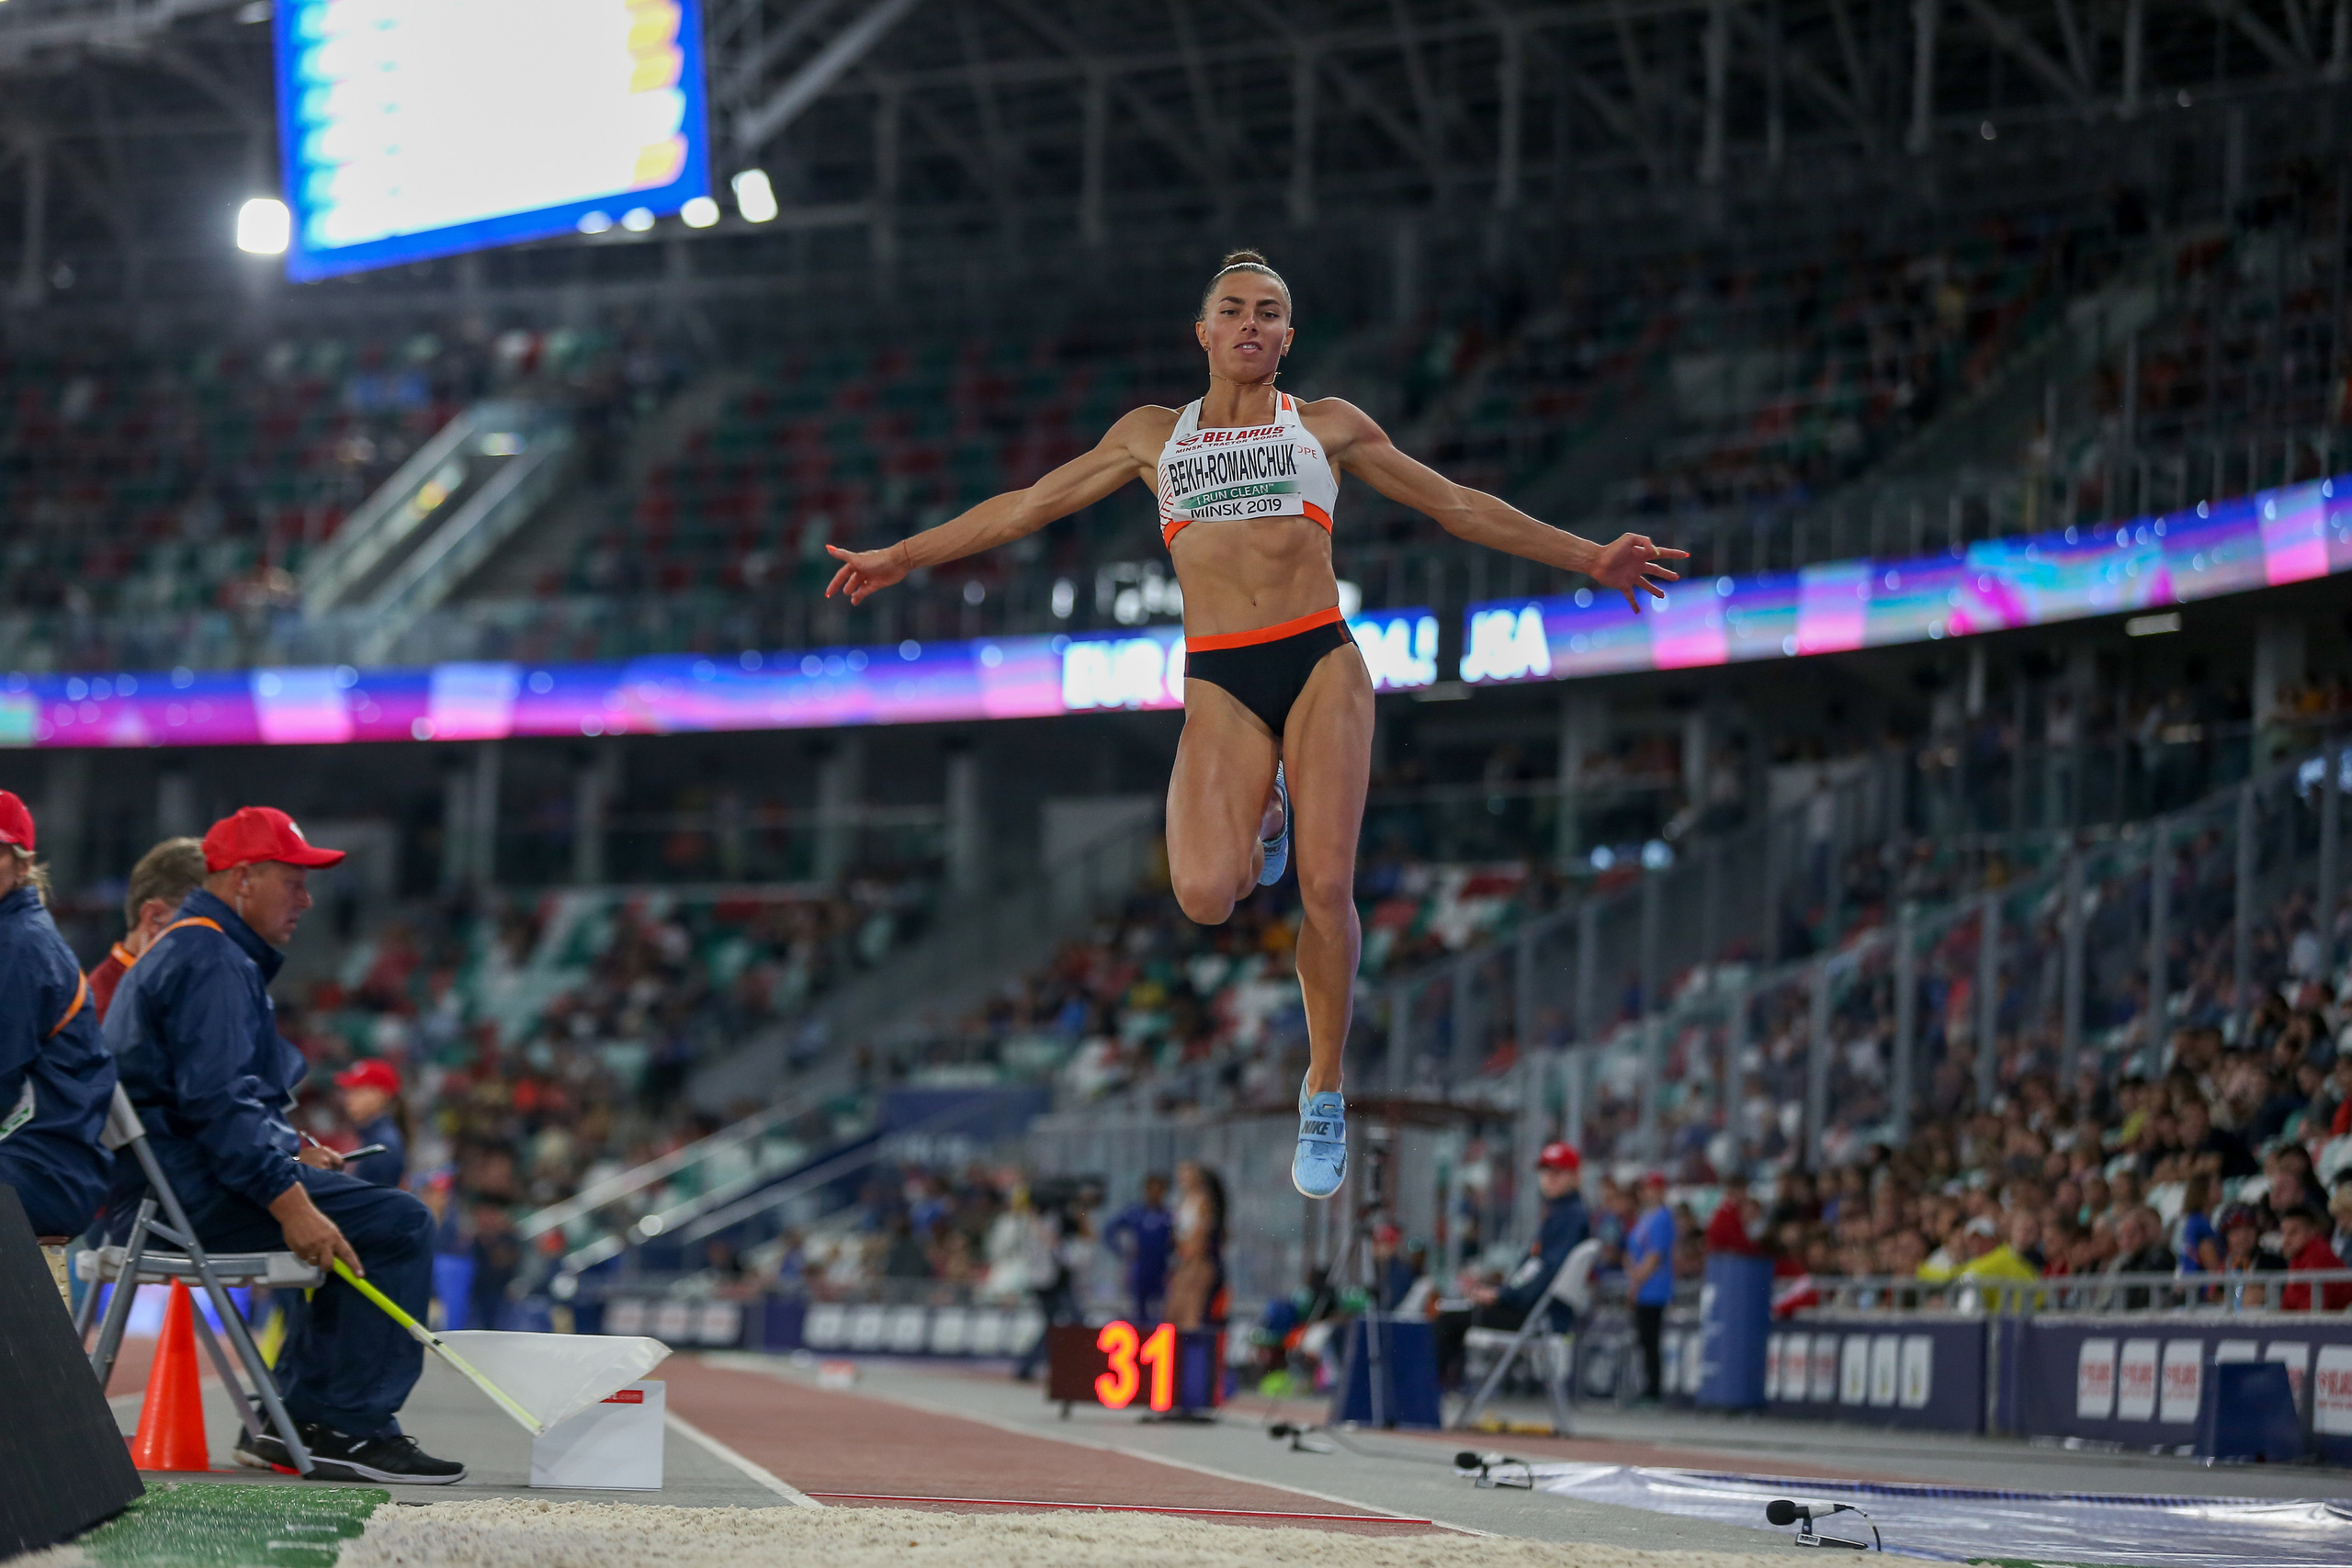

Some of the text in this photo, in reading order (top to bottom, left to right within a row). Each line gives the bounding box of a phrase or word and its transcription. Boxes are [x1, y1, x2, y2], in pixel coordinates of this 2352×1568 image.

[1175, 434, 1283, 454] MINSK TRACTOR WORKS
[1202, 426, 1285, 443] BELARUS
[1168, 444, 1297, 497] BEKH-ROMANCHUK
[1203, 491, 1227, 504] RUN
[1190, 498, 1283, 519] MINSK 2019
[1301, 1120, 1330, 1135] NIKE
[1094, 1320, 1177, 1412] 31
